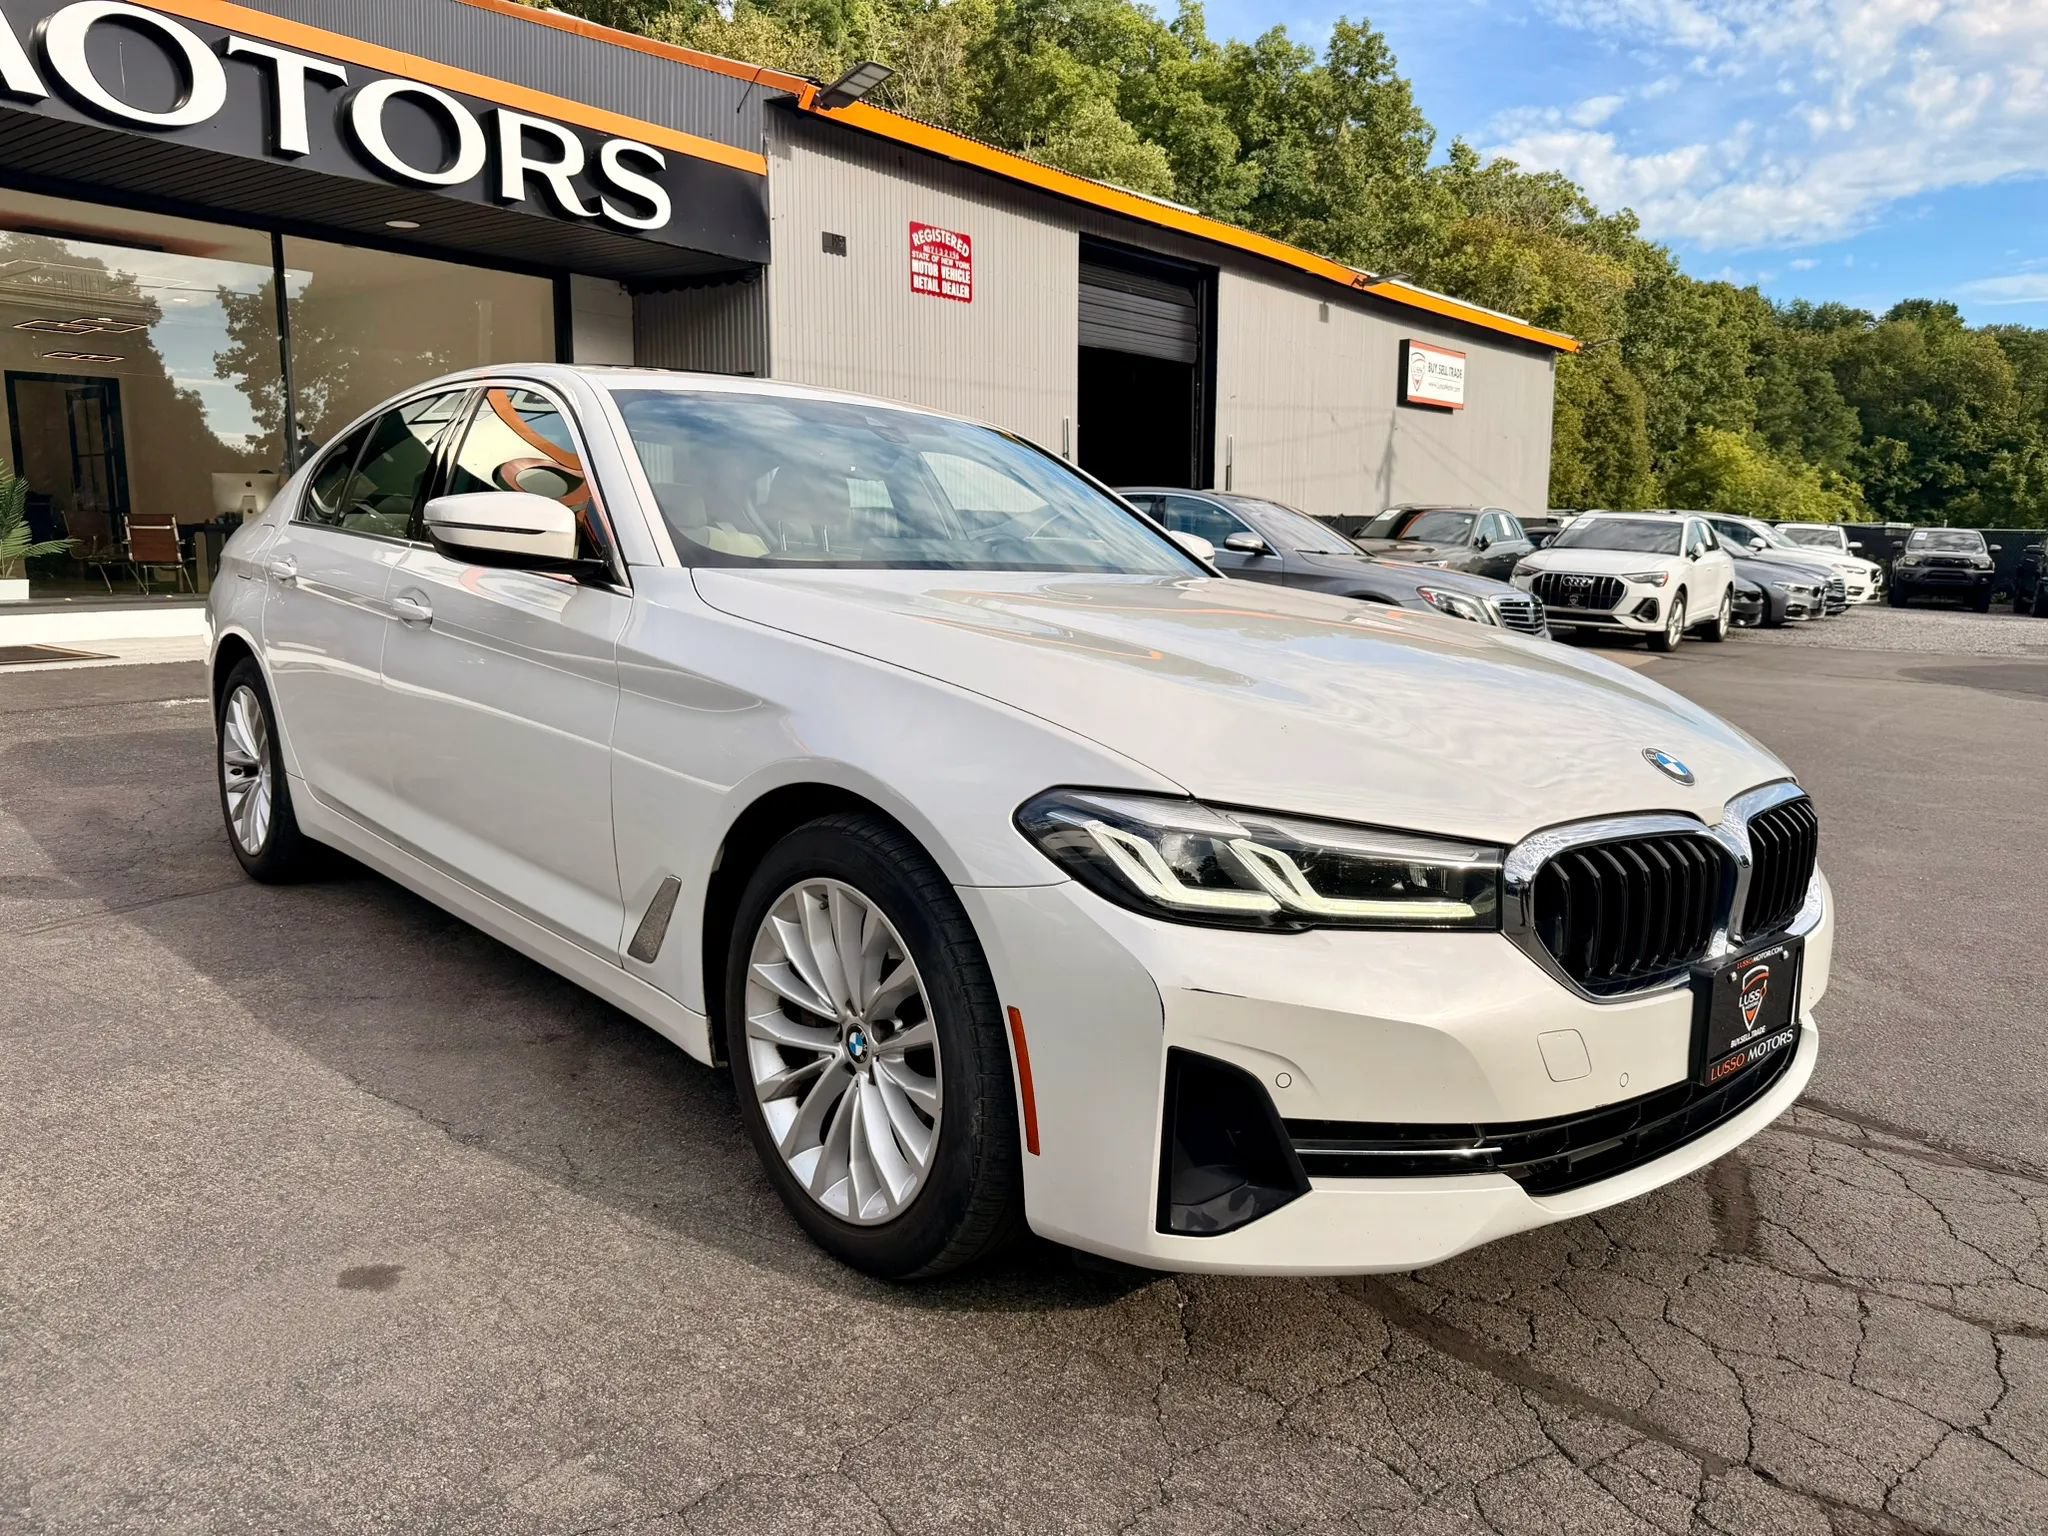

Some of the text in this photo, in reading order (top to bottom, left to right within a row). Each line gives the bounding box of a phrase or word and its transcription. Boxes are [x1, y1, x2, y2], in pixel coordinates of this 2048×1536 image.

[912, 229, 969, 257] REGISTERED
[912, 251, 930, 261] STATE
[941, 257, 954, 266] NEW
[955, 260, 971, 270] YORK
[912, 260, 971, 284] MOTOR VEHICLE
[913, 275, 970, 299] RETAIL DEALER
[1710, 1029, 1794, 1081] LUSSO MOTORS
